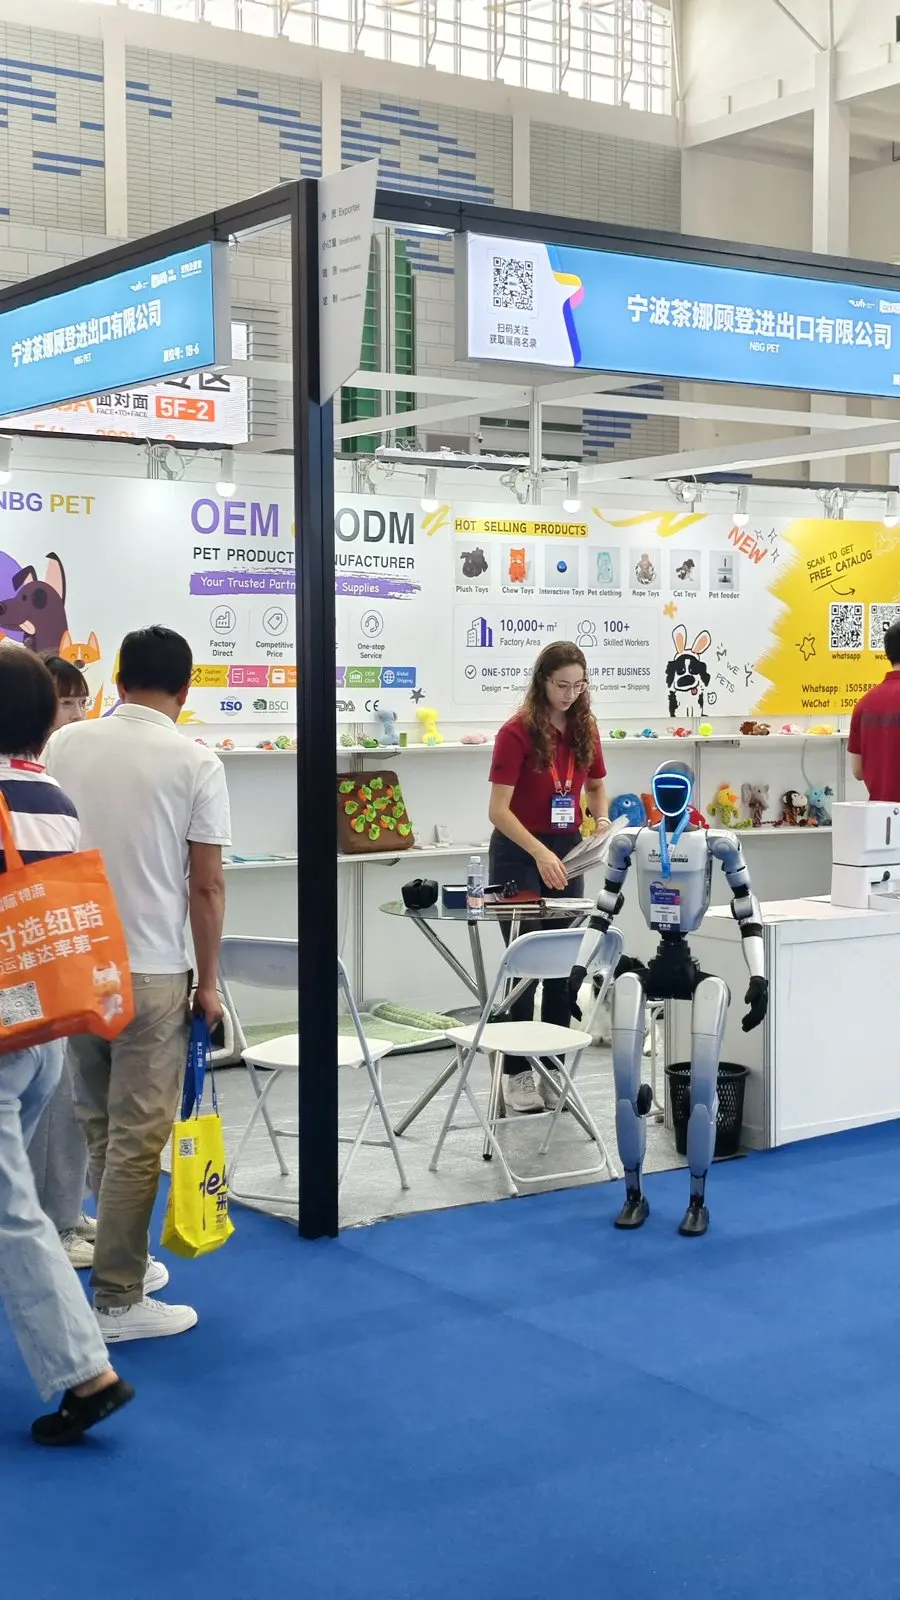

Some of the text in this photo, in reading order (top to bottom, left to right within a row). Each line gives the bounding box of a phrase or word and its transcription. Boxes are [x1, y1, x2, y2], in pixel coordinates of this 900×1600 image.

[339, 204, 360, 217] Exporter
[627, 294, 892, 350] 宁波茶娜顾登进出口有限公司
[11, 298, 162, 368] 宁波茶娜顾登进出口有限公司
[497, 323, 529, 336] 扫码关注
[489, 334, 537, 348] 获取展商名录
[750, 341, 780, 354] NBG PET
[96, 393, 148, 411] 面对面
[161, 398, 209, 419] 5F-2
[50, 494, 96, 515] PET
[191, 498, 279, 538] OEM
[335, 508, 415, 545] ODM
[455, 519, 587, 536] HOT SELLING PRODUCTS
[727, 525, 769, 565] NEW
[193, 547, 220, 561] PET
[806, 544, 854, 570] SCAN TO GET
[809, 549, 873, 584] FREE CATALOG
[200, 576, 296, 589] Your Trusted Partn
[342, 582, 380, 595] Supplies
[456, 585, 489, 594] Plush Toys
[520, 587, 534, 595] Toys
[539, 587, 585, 596] Interactive Toys
[708, 591, 719, 599] Pet
[500, 619, 558, 633] 10,000+ m²
[603, 620, 630, 633] 100+
[209, 639, 236, 650] Factory
[255, 640, 294, 651] Competitive
[357, 642, 386, 652] One-stop
[500, 637, 541, 647] Factory Area
[603, 639, 650, 647] Skilled Workers
[212, 649, 234, 657] Direct
[266, 650, 283, 658] Price
[360, 651, 383, 659] Service
[832, 652, 861, 661] whatsapp
[481, 667, 521, 677] ONE-STOP
[601, 667, 615, 676] PET
[617, 667, 651, 676] BUSINESS
[726, 660, 740, 675] WE
[481, 684, 501, 693] Design
[600, 683, 619, 691] Control
[627, 683, 650, 692] Shipping
[715, 672, 735, 693] PETS
[220, 701, 243, 711] ISO
[268, 700, 289, 710] BSCI
[364, 699, 380, 712] CE
[801, 699, 830, 708] WeChat
